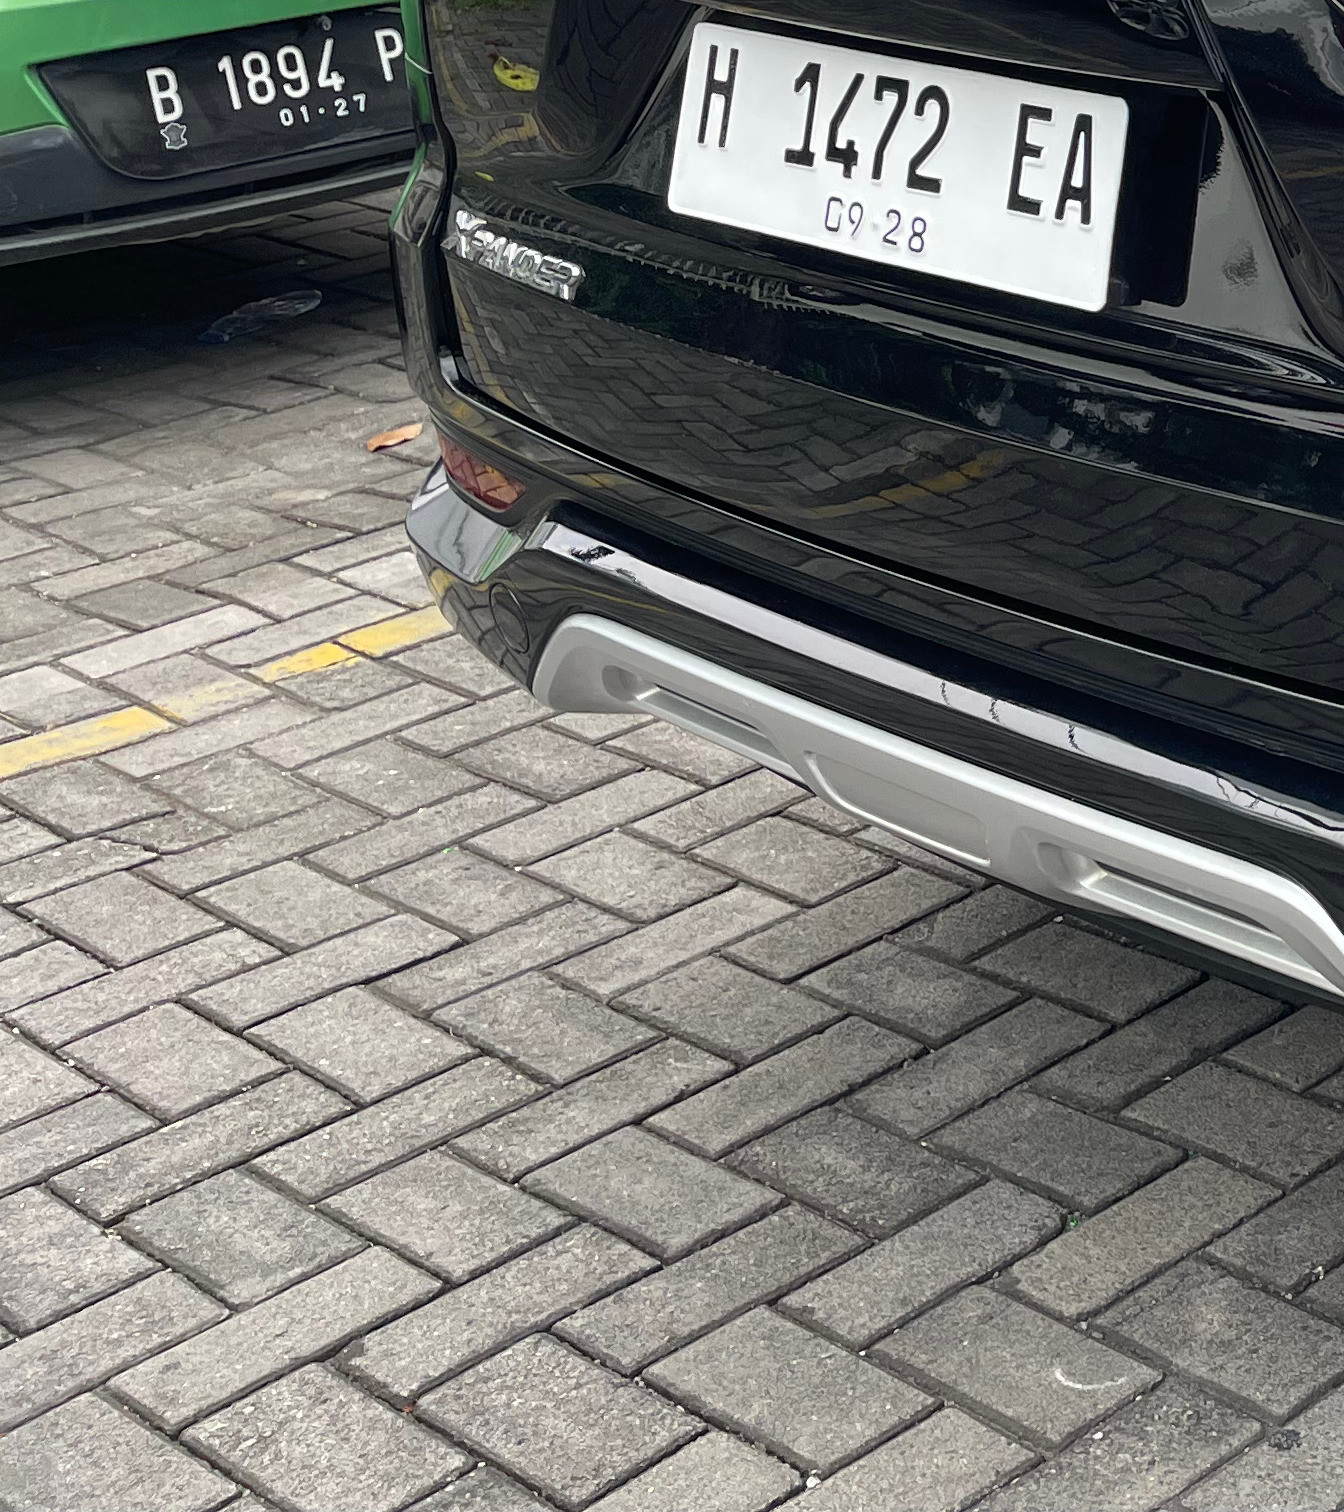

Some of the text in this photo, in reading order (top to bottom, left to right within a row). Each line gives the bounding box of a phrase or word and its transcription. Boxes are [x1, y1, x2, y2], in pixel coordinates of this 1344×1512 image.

[146, 66, 184, 124] B
[217, 38, 346, 112] 1894
[697, 44, 1094, 226] H 1472 EA
